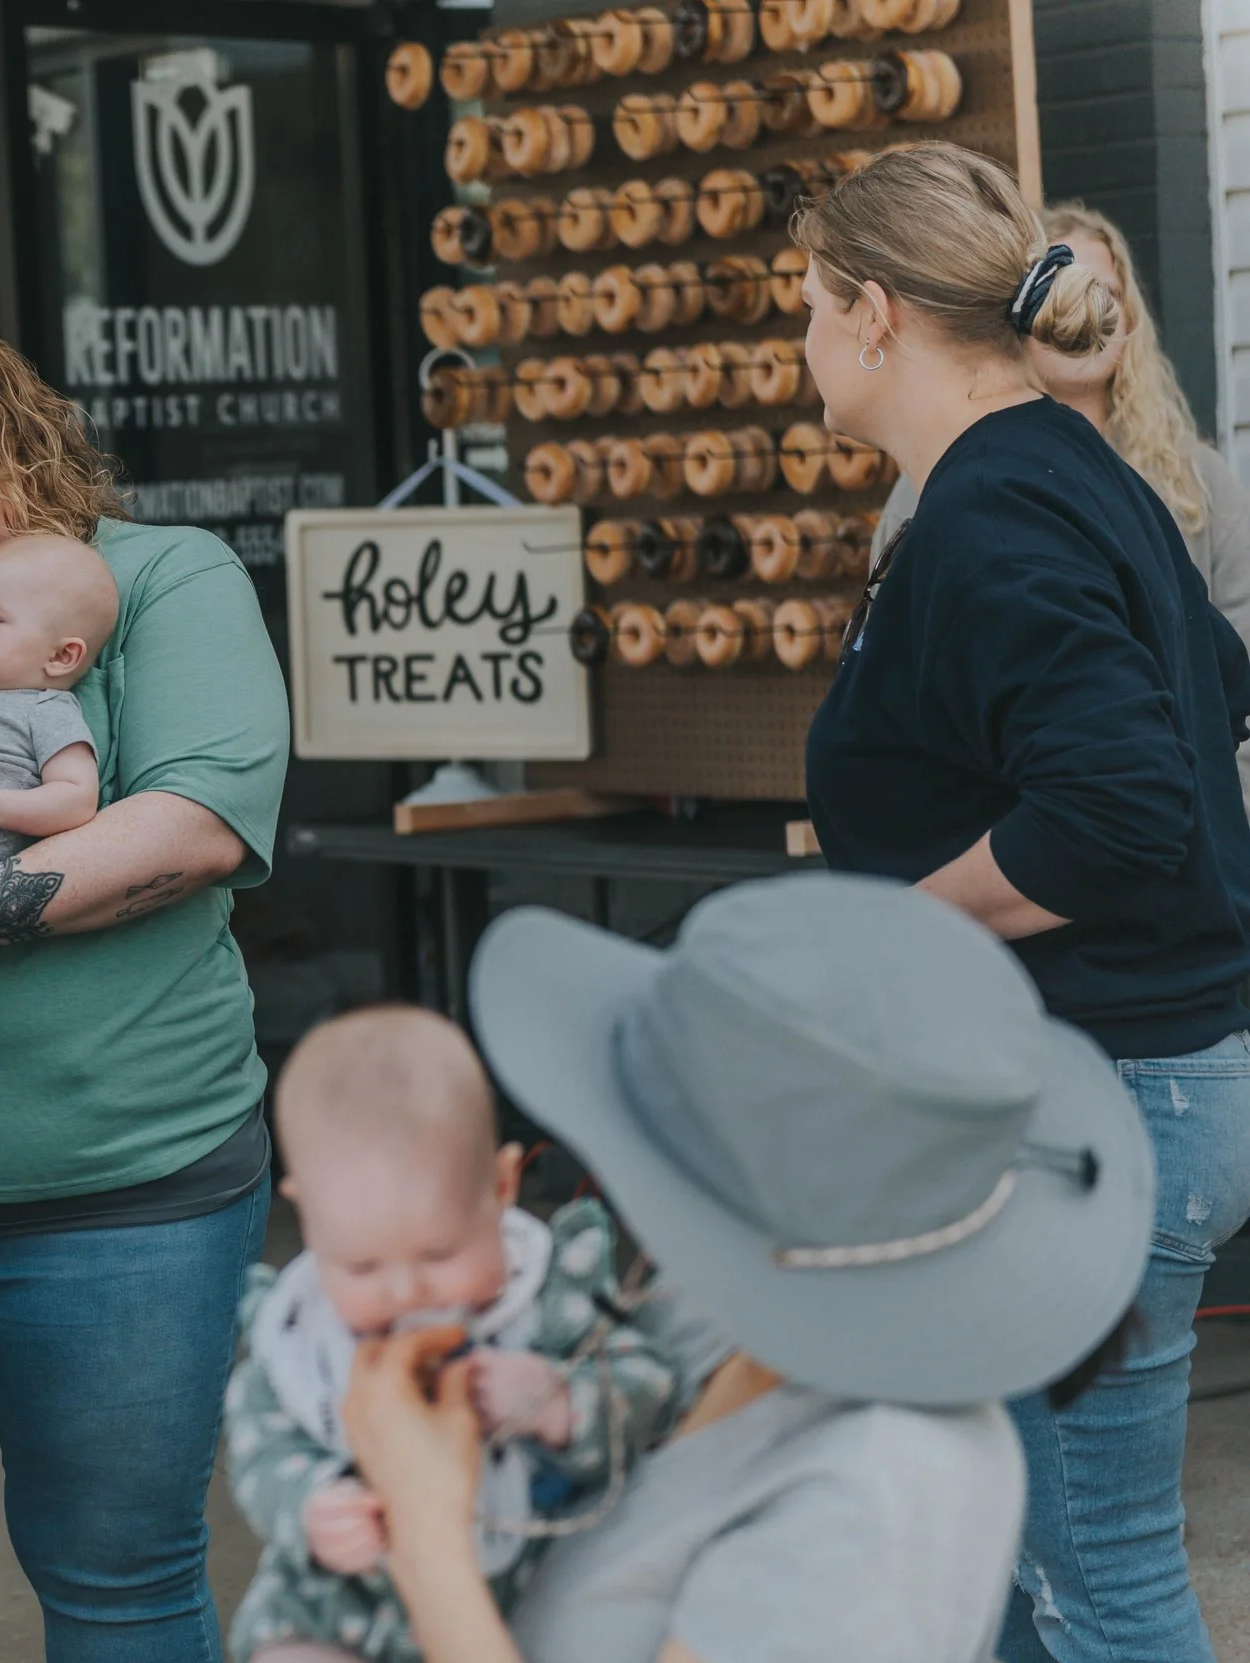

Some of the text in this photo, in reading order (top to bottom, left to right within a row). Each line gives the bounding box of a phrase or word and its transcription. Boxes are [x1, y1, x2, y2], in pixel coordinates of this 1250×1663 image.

[63, 304, 337, 386] REFORMATION
[216, 390, 341, 426] CHURCH
[322, 537, 558, 645] holey
[332, 651, 544, 704] TREATS
